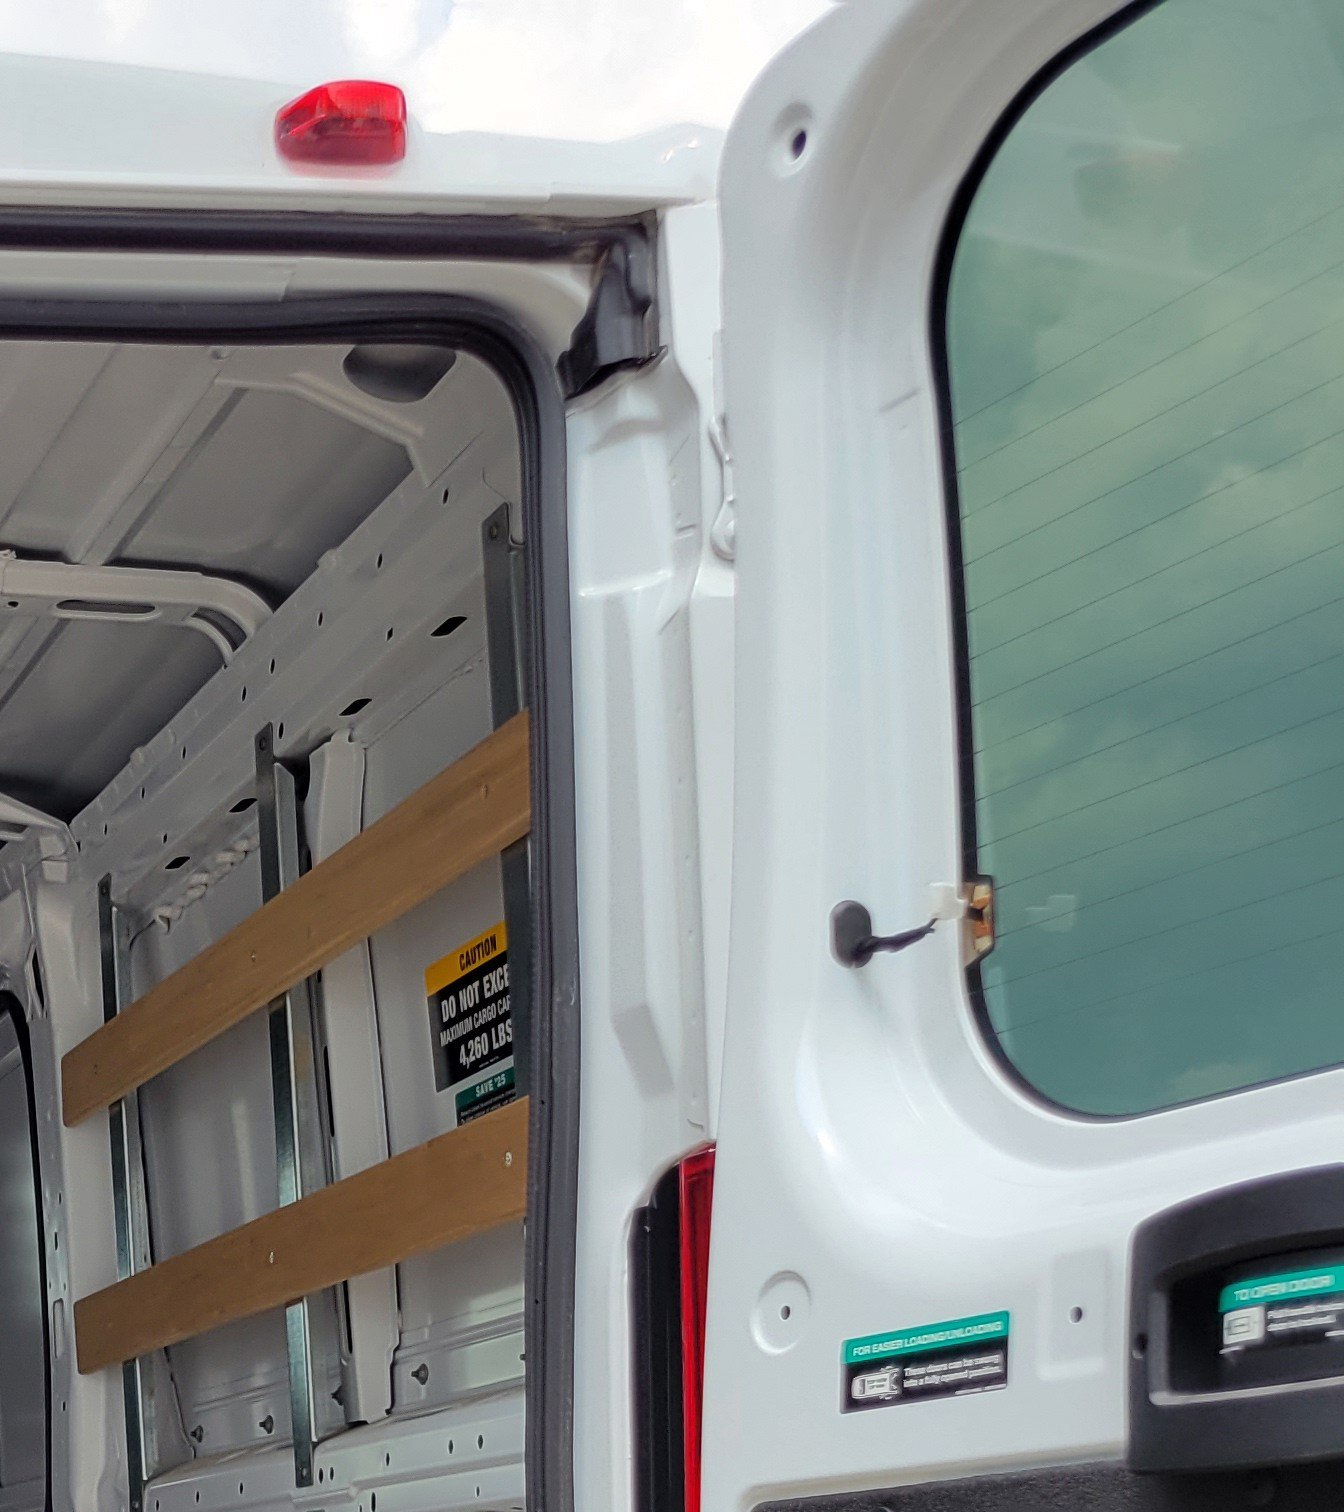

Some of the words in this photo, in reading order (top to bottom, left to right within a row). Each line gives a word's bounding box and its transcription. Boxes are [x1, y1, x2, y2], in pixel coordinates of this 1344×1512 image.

[459, 934, 497, 971] CAUTION
[441, 997, 457, 1023] DO
[459, 982, 480, 1010] NOT
[439, 1016, 473, 1048] MAXIMUM
[473, 1002, 497, 1026] CARGO
[459, 1032, 489, 1070] 4,260
[475, 1077, 494, 1098] SAVE
[852, 1346, 872, 1357] FOR
[872, 1339, 903, 1354] EASIER
[904, 1321, 1003, 1348] LOADING/UNLOADING
